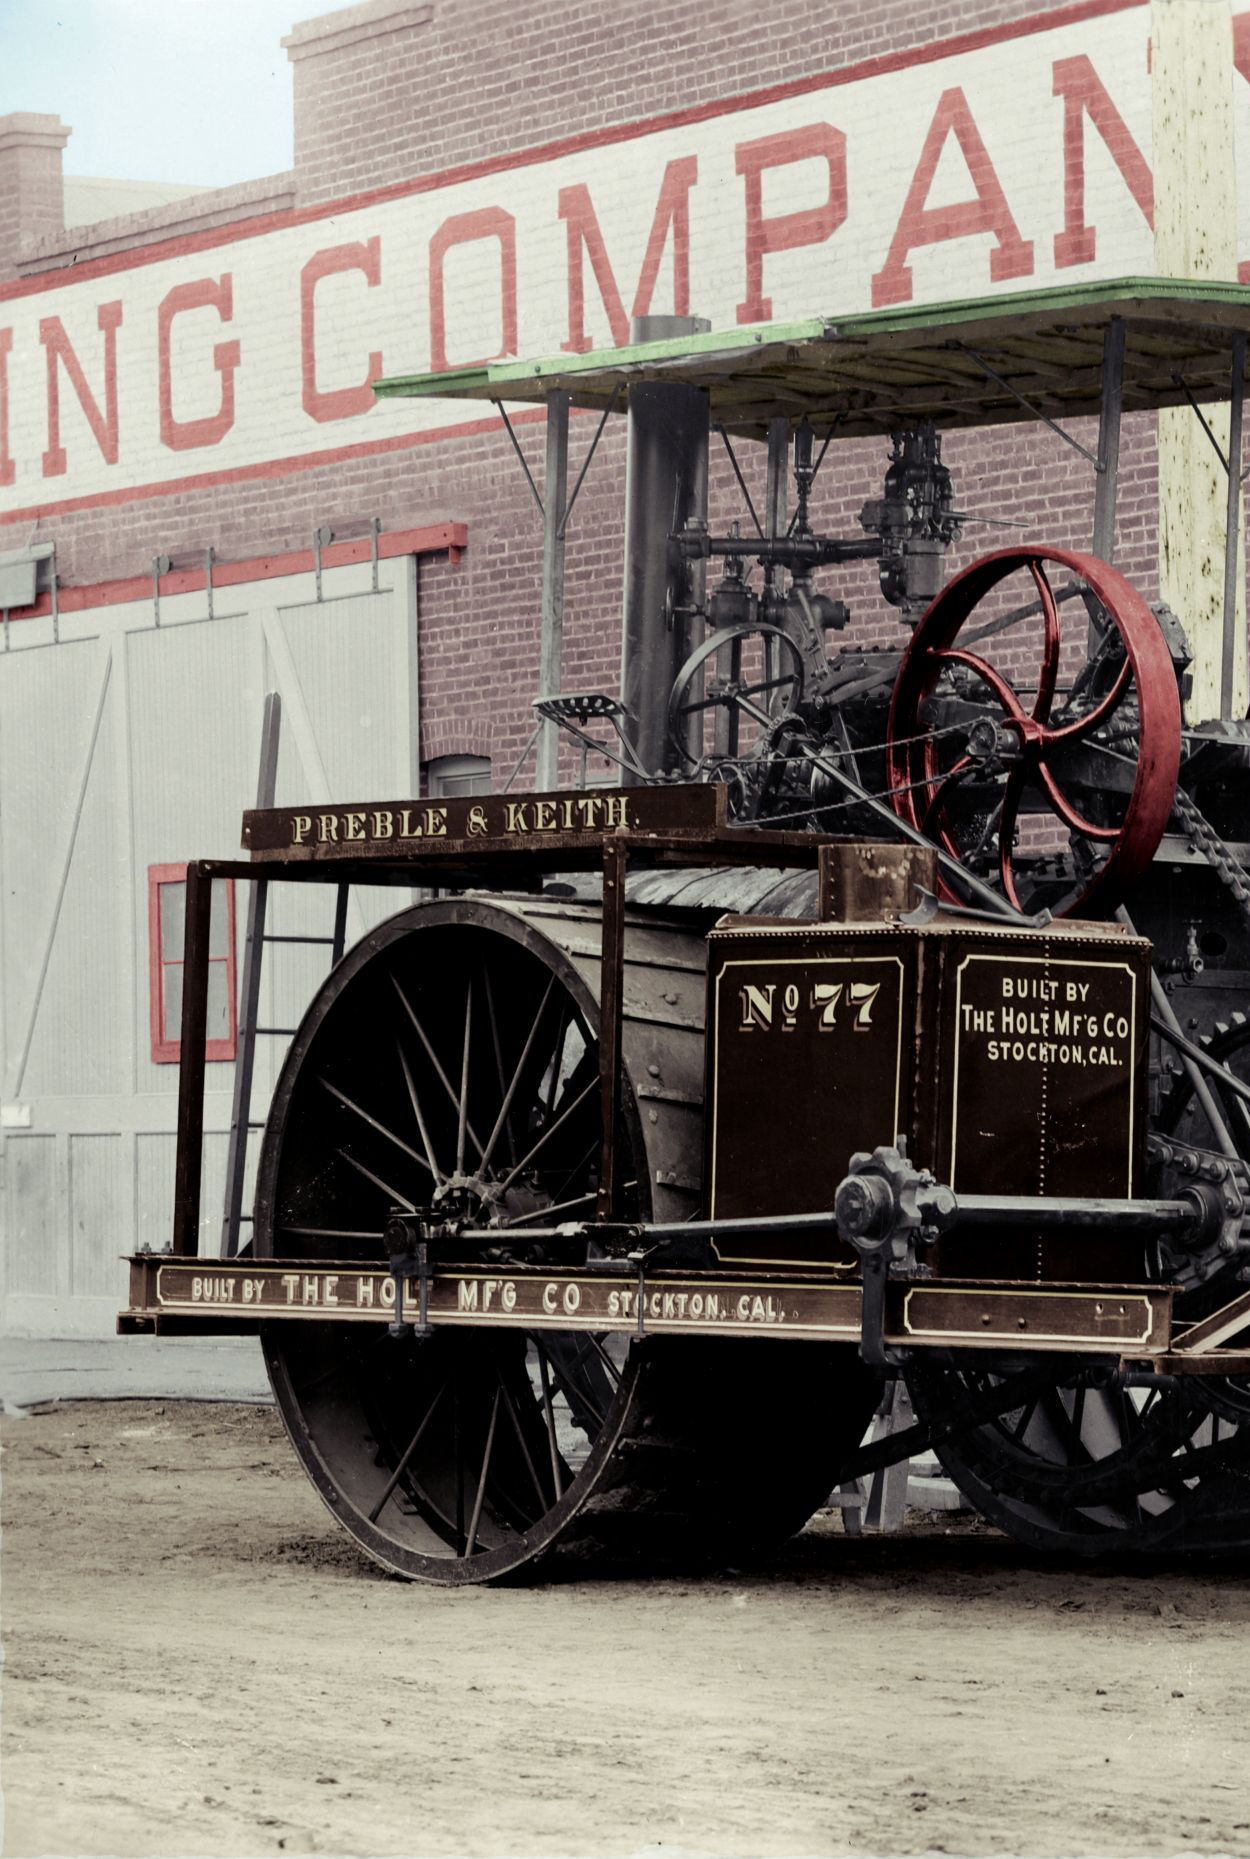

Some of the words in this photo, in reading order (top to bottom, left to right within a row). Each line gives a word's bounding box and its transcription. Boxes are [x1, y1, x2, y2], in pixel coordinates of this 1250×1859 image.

[290, 807, 448, 845] PREBLE
[467, 805, 488, 836] &
[504, 797, 640, 834] KEITH.
[812, 982, 881, 1028] 77
[1002, 977, 1059, 1000] BUILT
[1066, 982, 1090, 1002] BY
[961, 1004, 995, 1033] THE
[1001, 1006, 1049, 1037] HOLT
[1054, 1010, 1098, 1038] MF'G
[1103, 1012, 1129, 1038] CO
[1088, 1046, 1123, 1066] CAL.
[191, 1277, 236, 1302] BUILT
[242, 1278, 266, 1303] BY
[281, 1274, 339, 1306] THE
[357, 1276, 434, 1308] HOL
[458, 1279, 517, 1313] MF'G
[542, 1282, 580, 1315] CO
